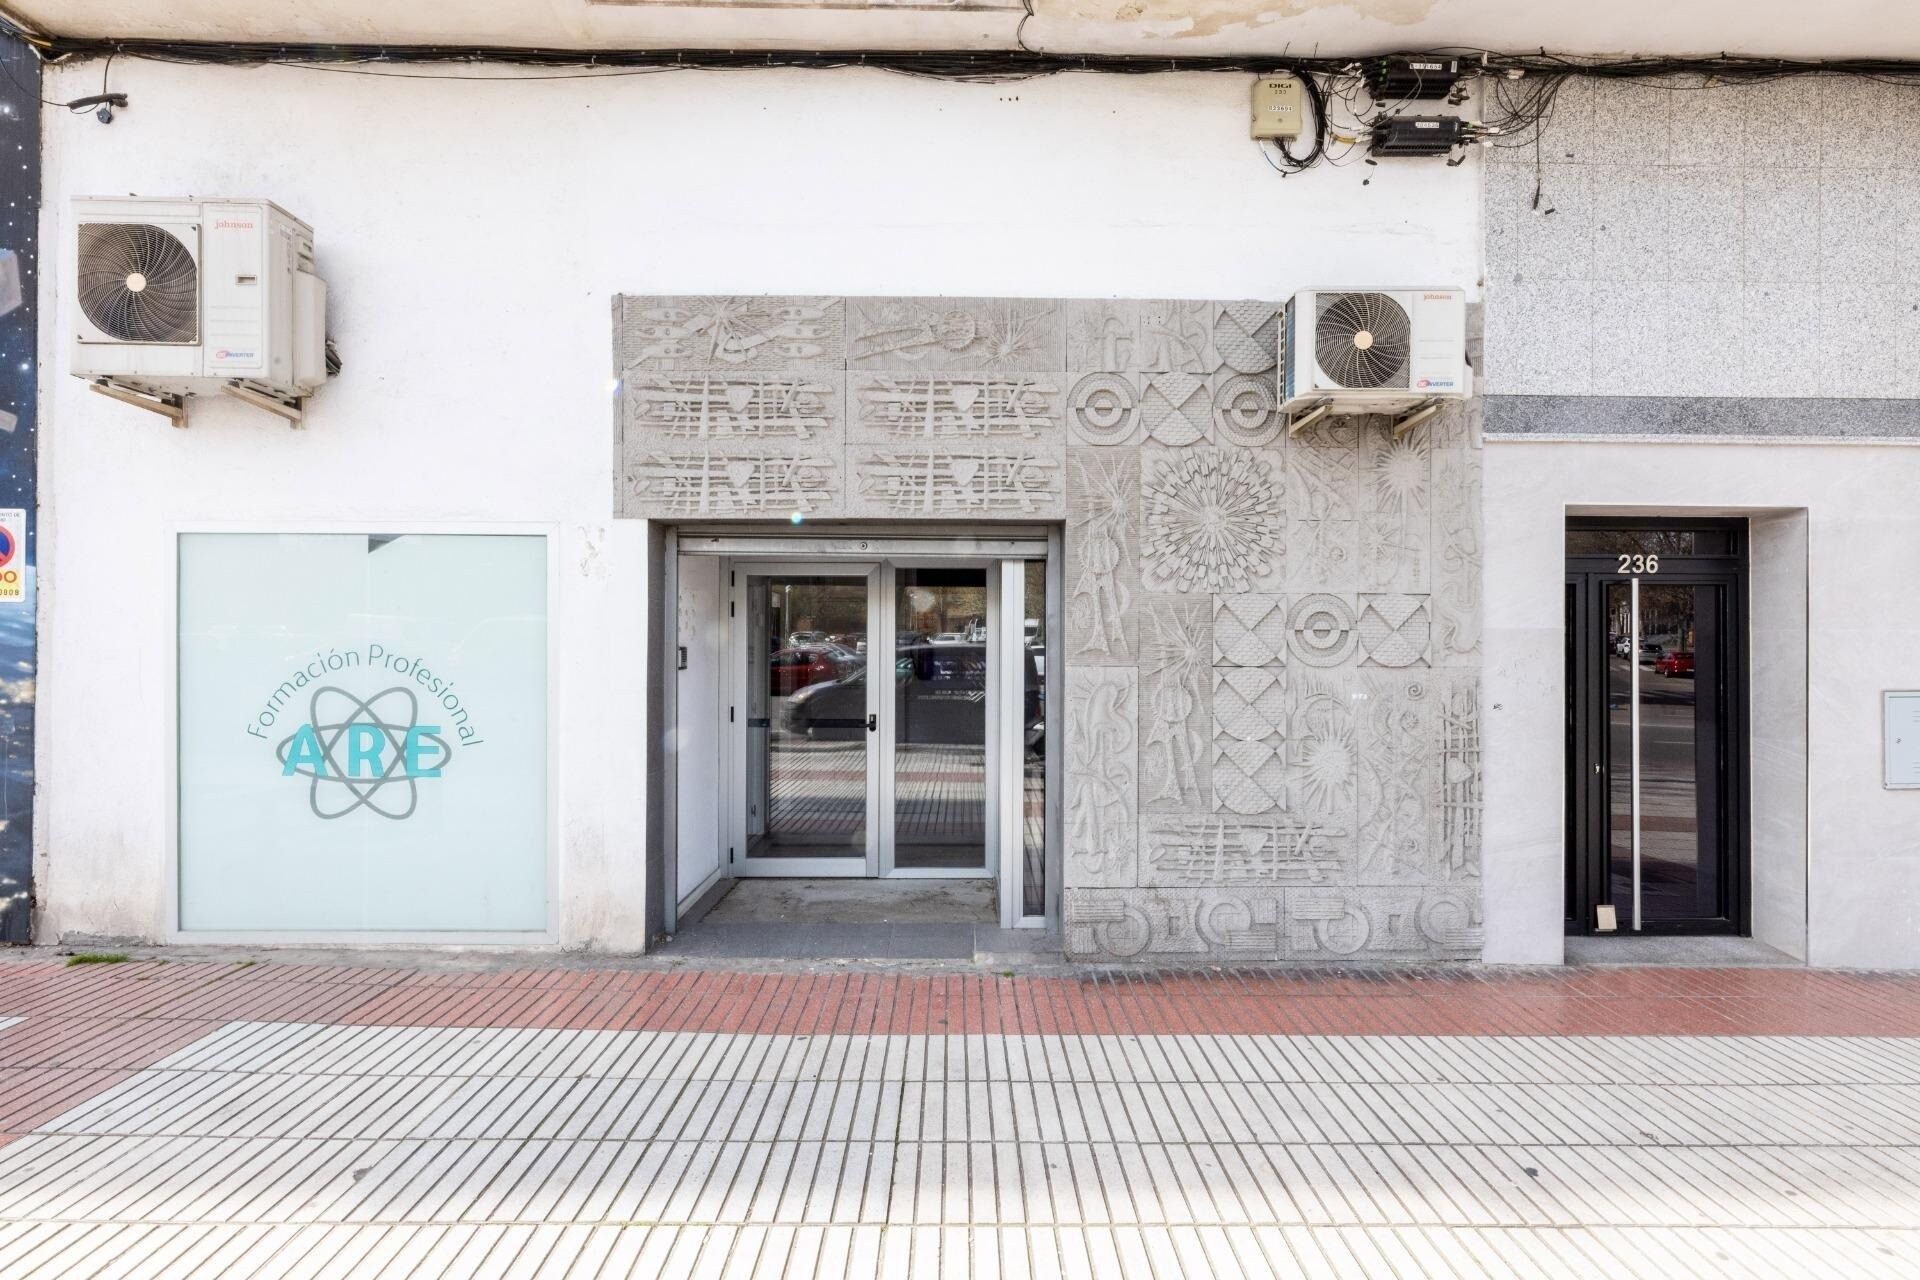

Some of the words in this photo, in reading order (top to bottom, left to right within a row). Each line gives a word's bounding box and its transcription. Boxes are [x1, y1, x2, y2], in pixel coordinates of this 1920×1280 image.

[216, 221, 253, 230] johnson
[1618, 554, 1659, 574] 236
[247, 648, 360, 739] Formación
[368, 644, 484, 747] Profesional
[281, 723, 442, 778] ARE
